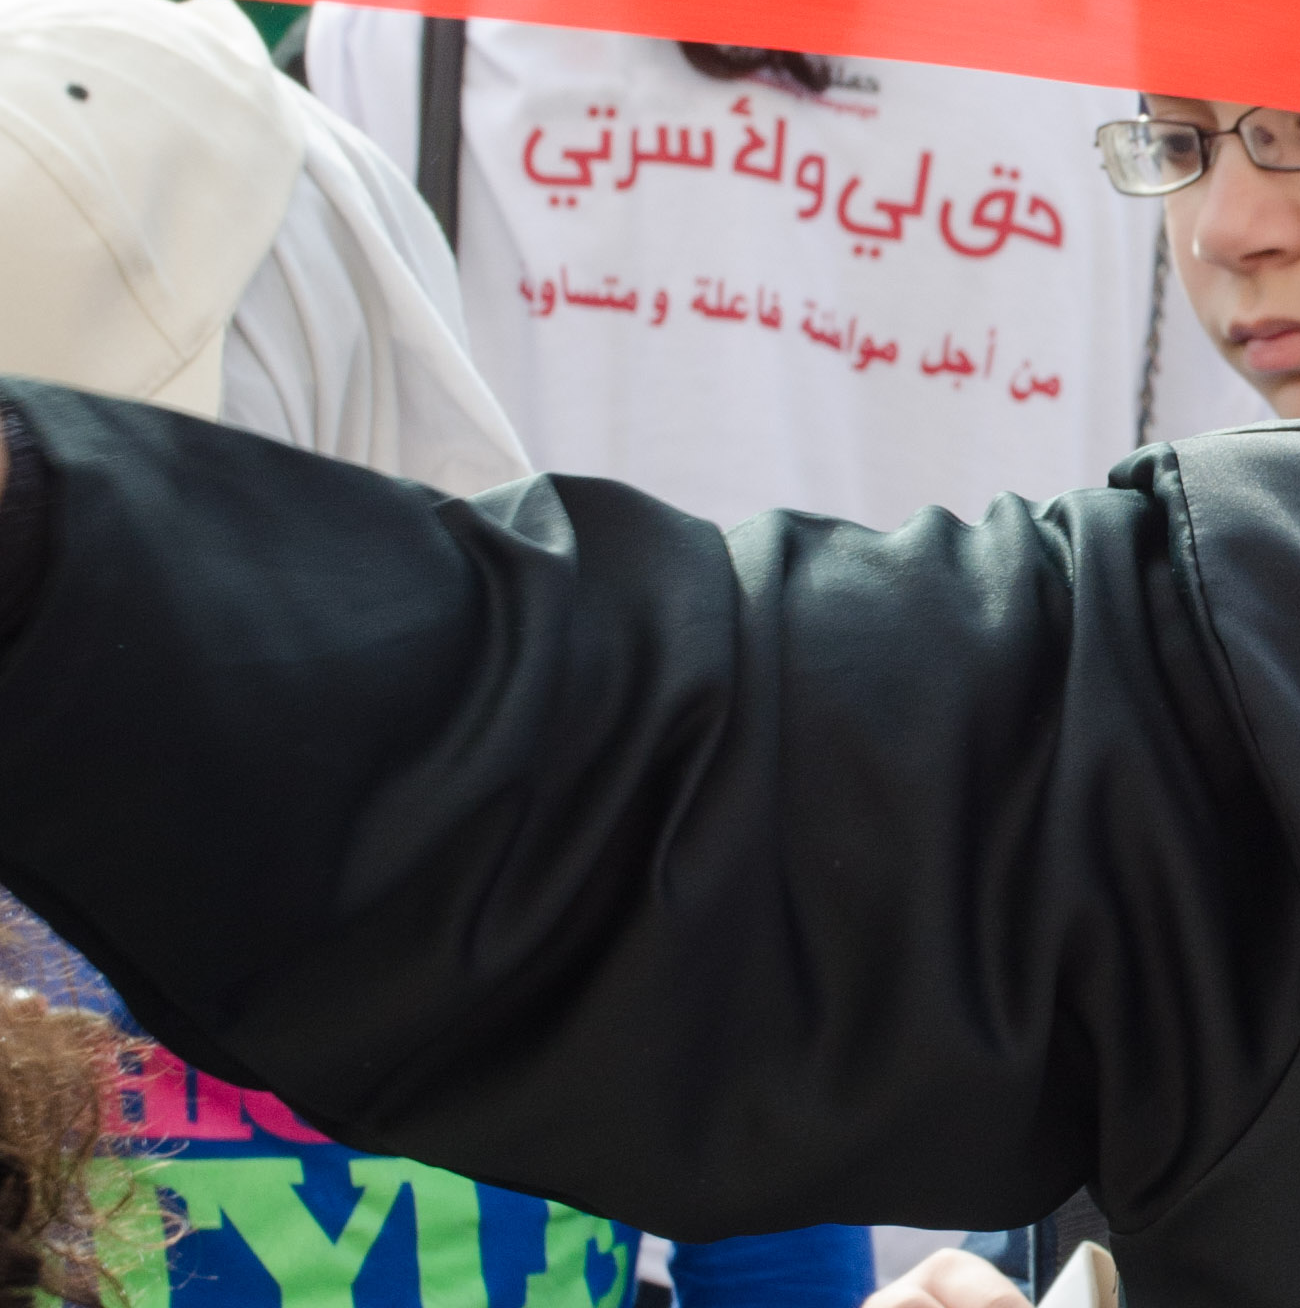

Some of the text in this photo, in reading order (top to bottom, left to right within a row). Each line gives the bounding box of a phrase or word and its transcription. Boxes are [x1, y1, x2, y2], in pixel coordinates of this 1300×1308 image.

[837, 150, 933, 259] لي
[939, 162, 1065, 258] حق
[919, 326, 996, 389] أجل
[1008, 359, 1062, 403] من
